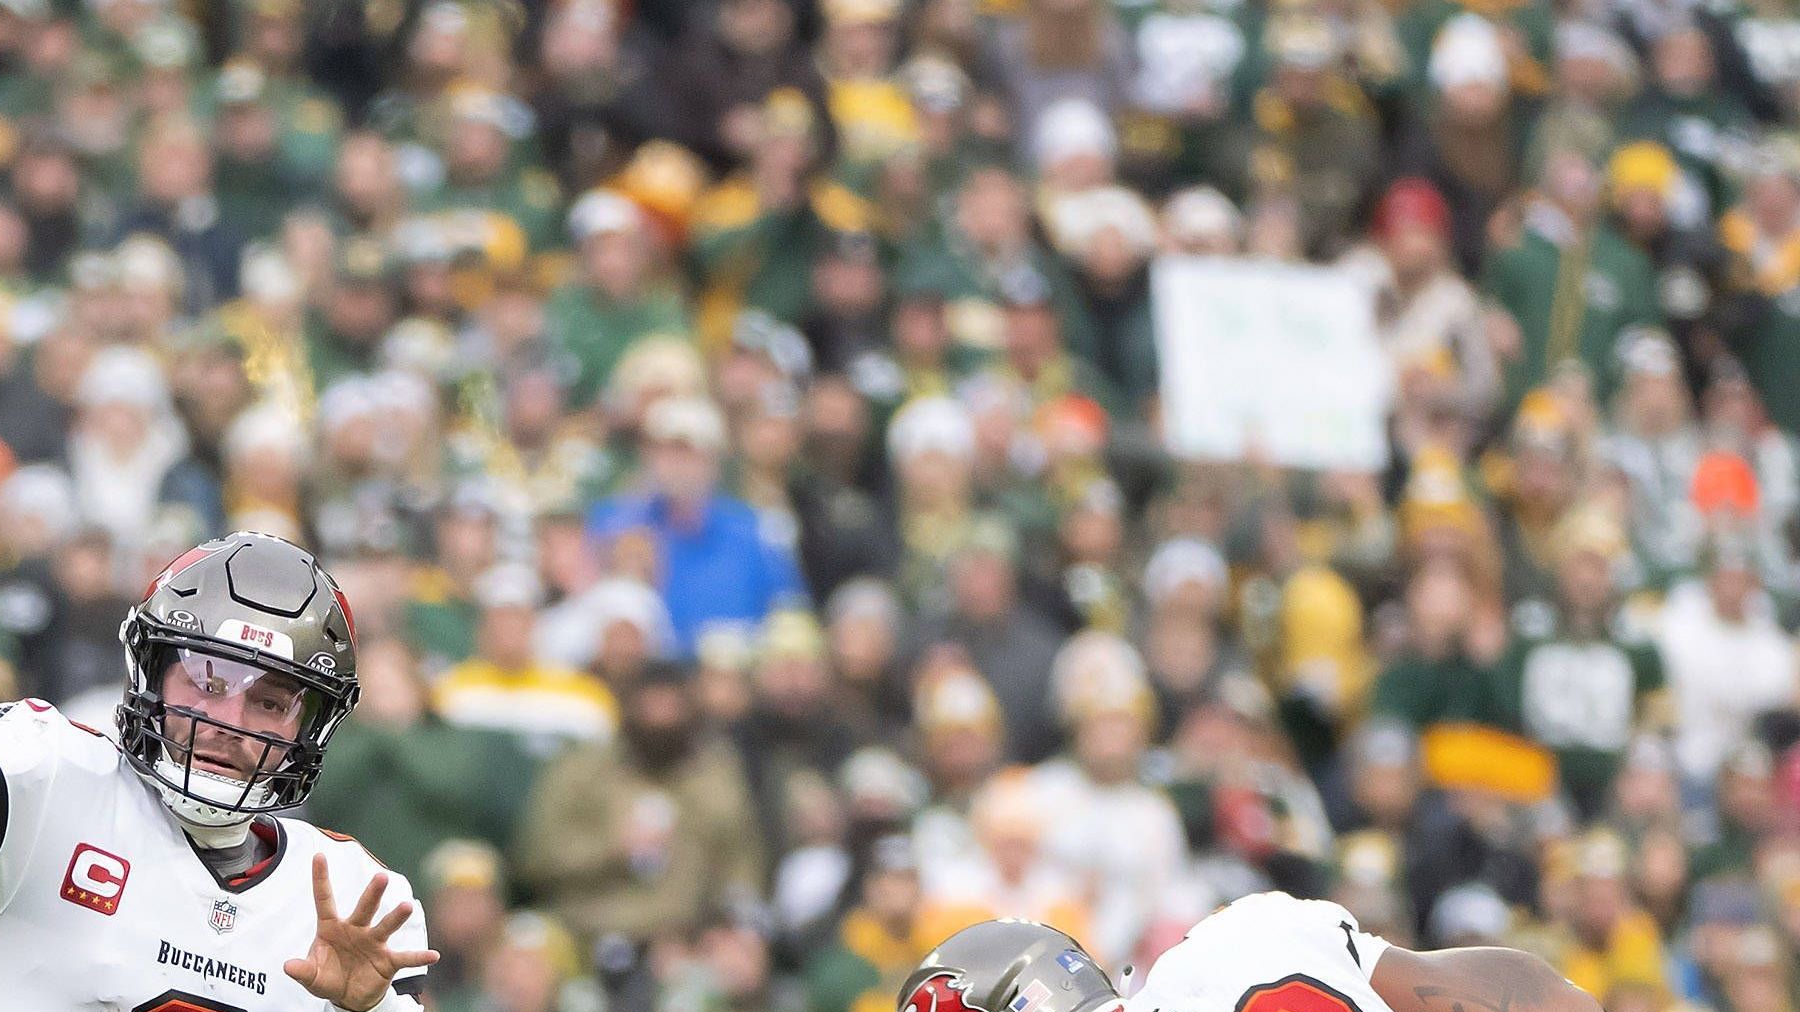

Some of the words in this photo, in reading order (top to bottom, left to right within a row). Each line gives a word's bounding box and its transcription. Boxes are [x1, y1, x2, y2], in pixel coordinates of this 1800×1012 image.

[167, 618, 200, 630] OAKLEY
[71, 849, 125, 899] C
[213, 910, 232, 927] NFL
[157, 939, 267, 995] BUCCANEERS
